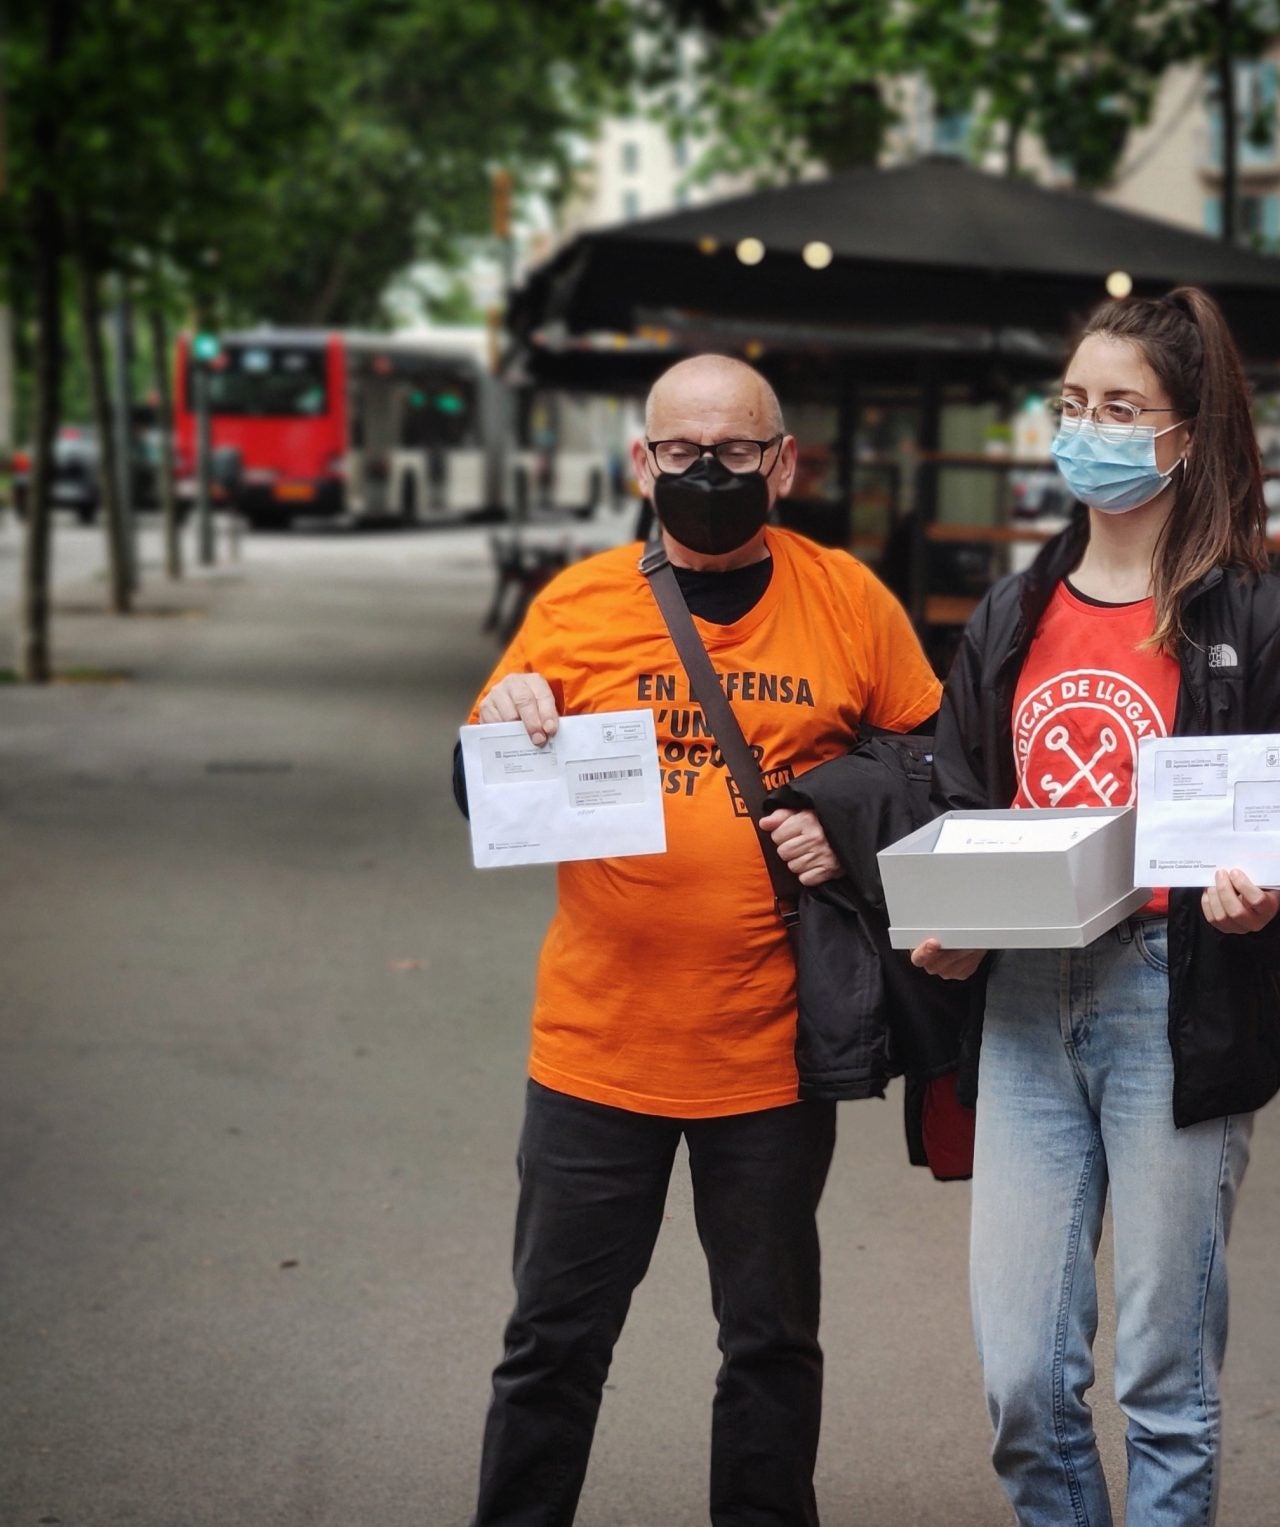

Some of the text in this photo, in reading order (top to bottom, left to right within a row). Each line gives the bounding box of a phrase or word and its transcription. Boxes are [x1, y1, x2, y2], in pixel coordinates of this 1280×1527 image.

[638, 671, 815, 708] EN FENSA
[1061, 680, 1090, 699] DE
[658, 709, 715, 738] 'UN
